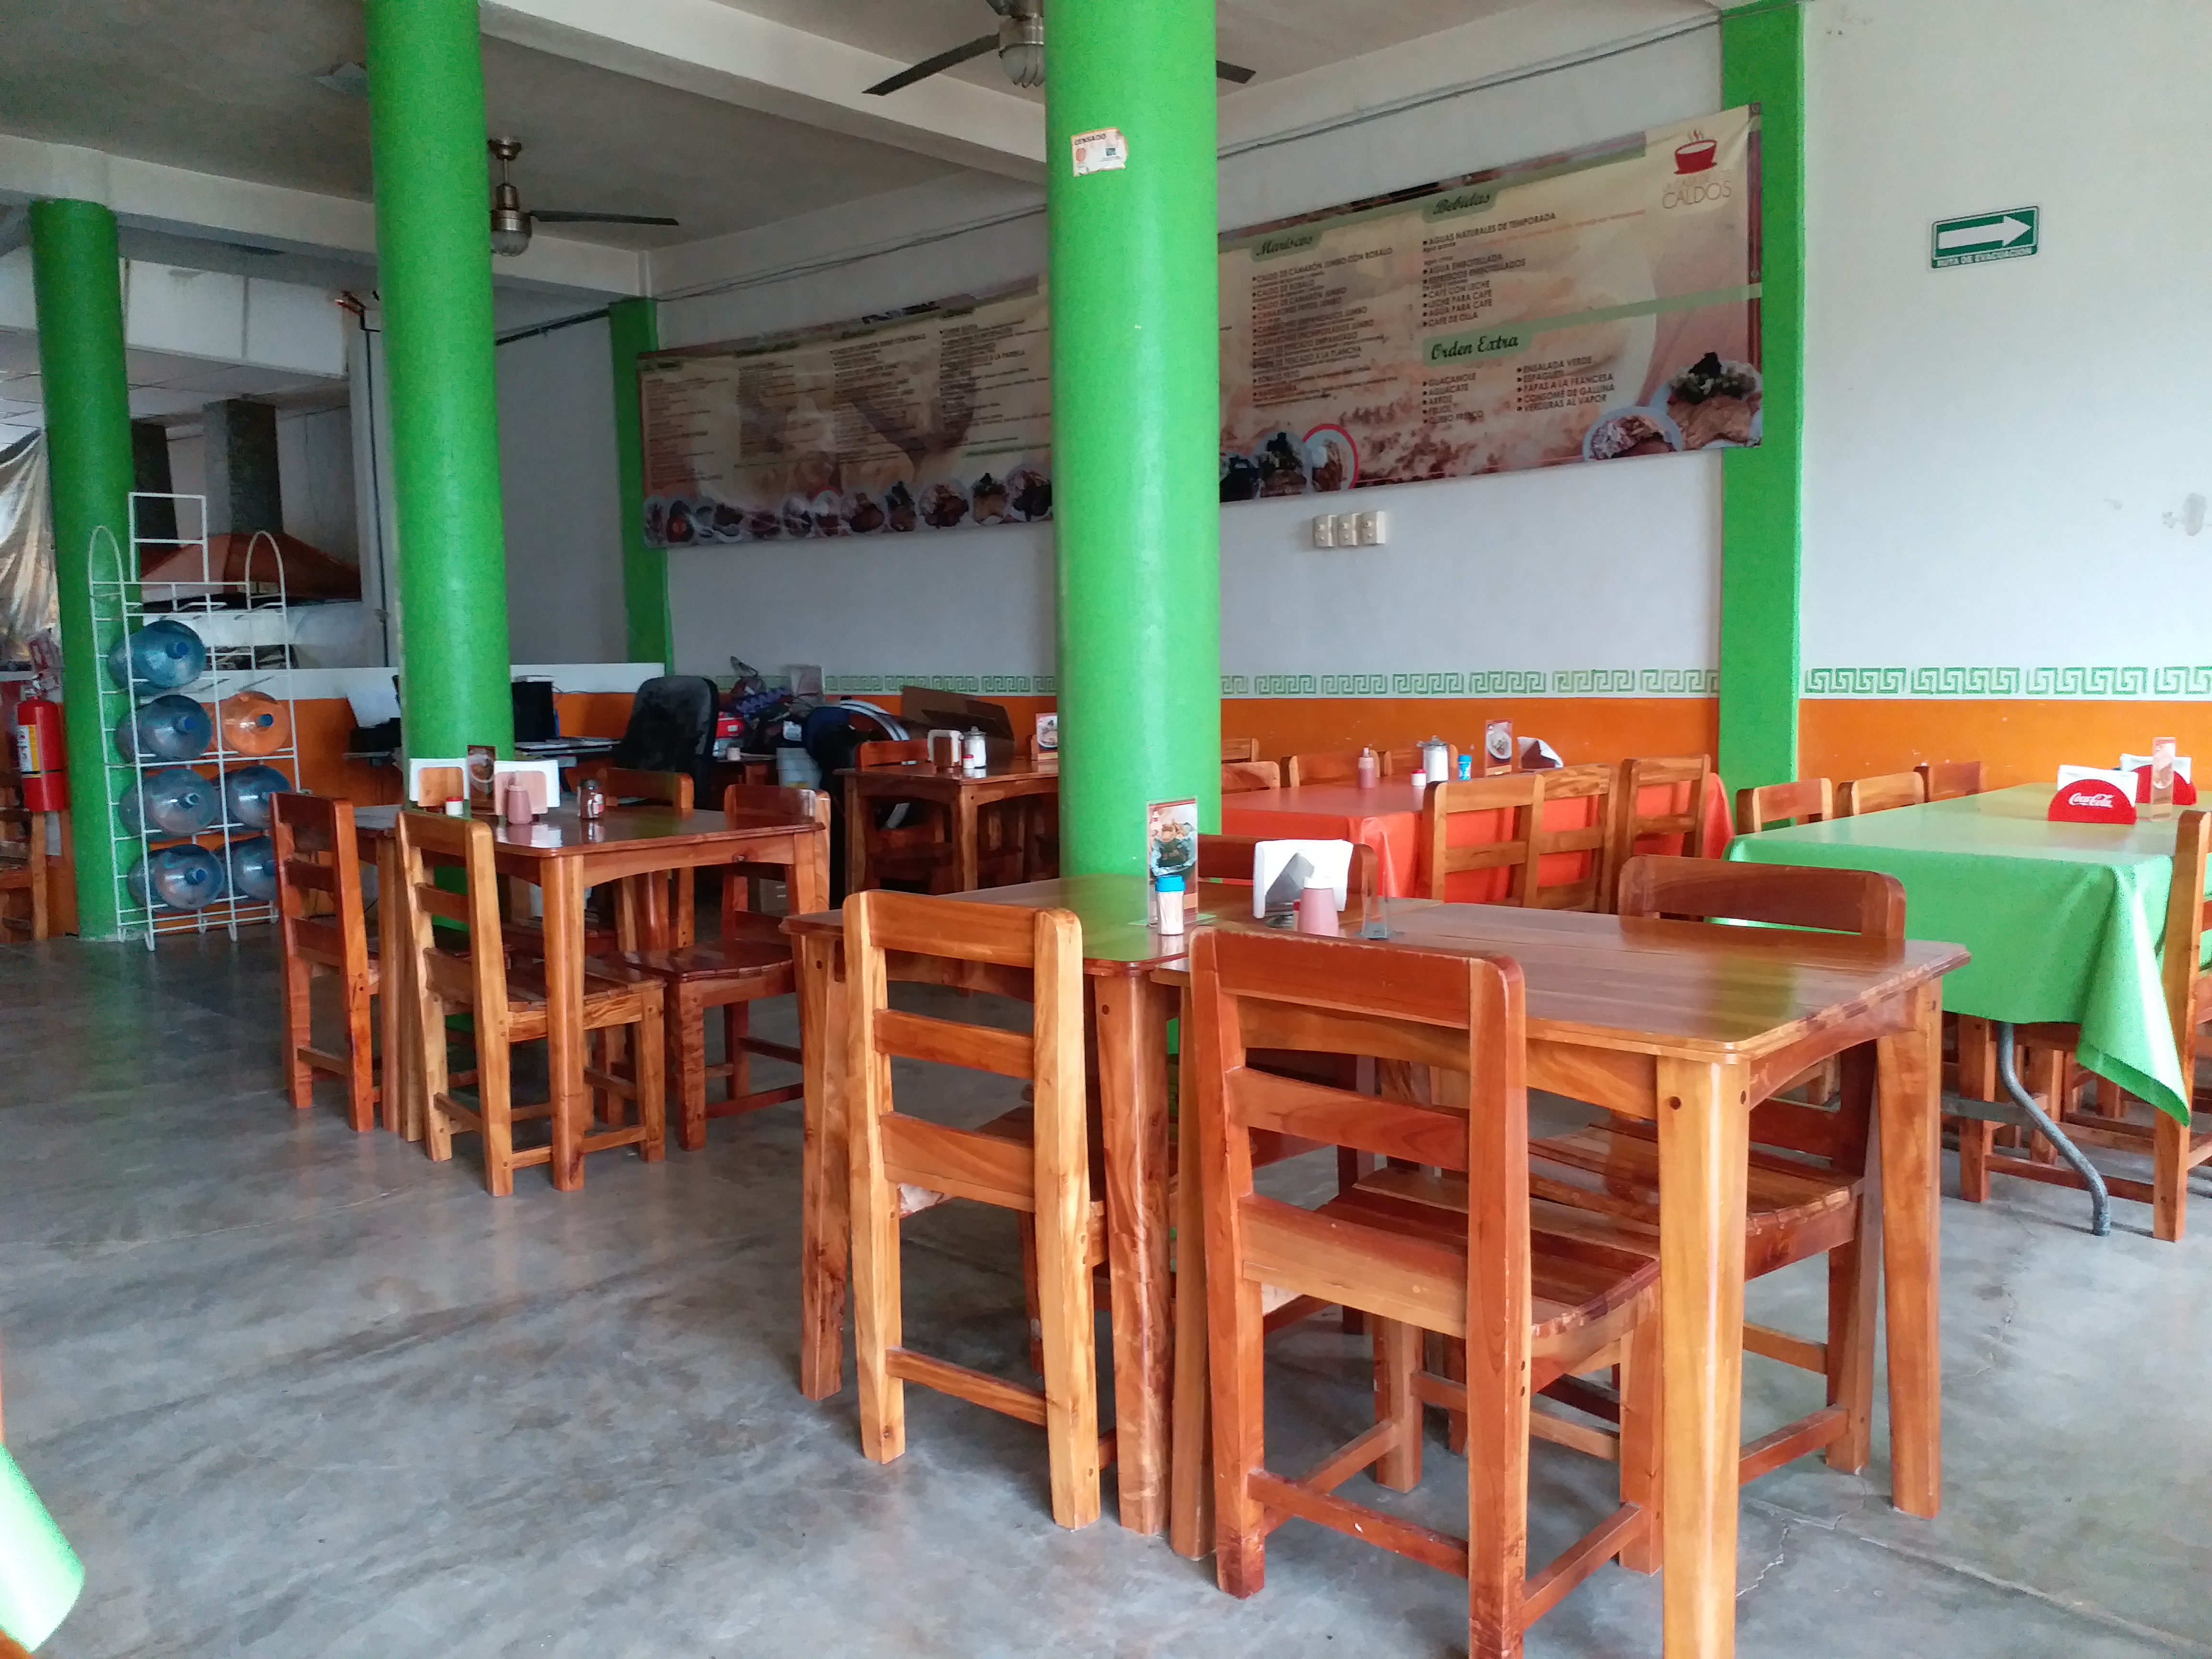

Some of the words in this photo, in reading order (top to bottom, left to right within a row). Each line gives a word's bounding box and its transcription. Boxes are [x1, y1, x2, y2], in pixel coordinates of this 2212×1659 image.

[1662, 181, 1731, 209] CALDOS
[1429, 233, 1454, 245] AGUAS
[1455, 224, 1496, 239] NATURALES
[1497, 223, 1507, 231] DE
[1509, 212, 1556, 228] TEMPORADA
[1431, 340, 1473, 360] Orden
[1478, 336, 1519, 352] Extra
[1524, 383, 1548, 392] PAPAS
[1558, 379, 1568, 387] LA
[1570, 373, 1613, 386] FRANCESA
[1579, 394, 1606, 405] VAPOR
[2068, 792, 2115, 808] Coca-Cola
